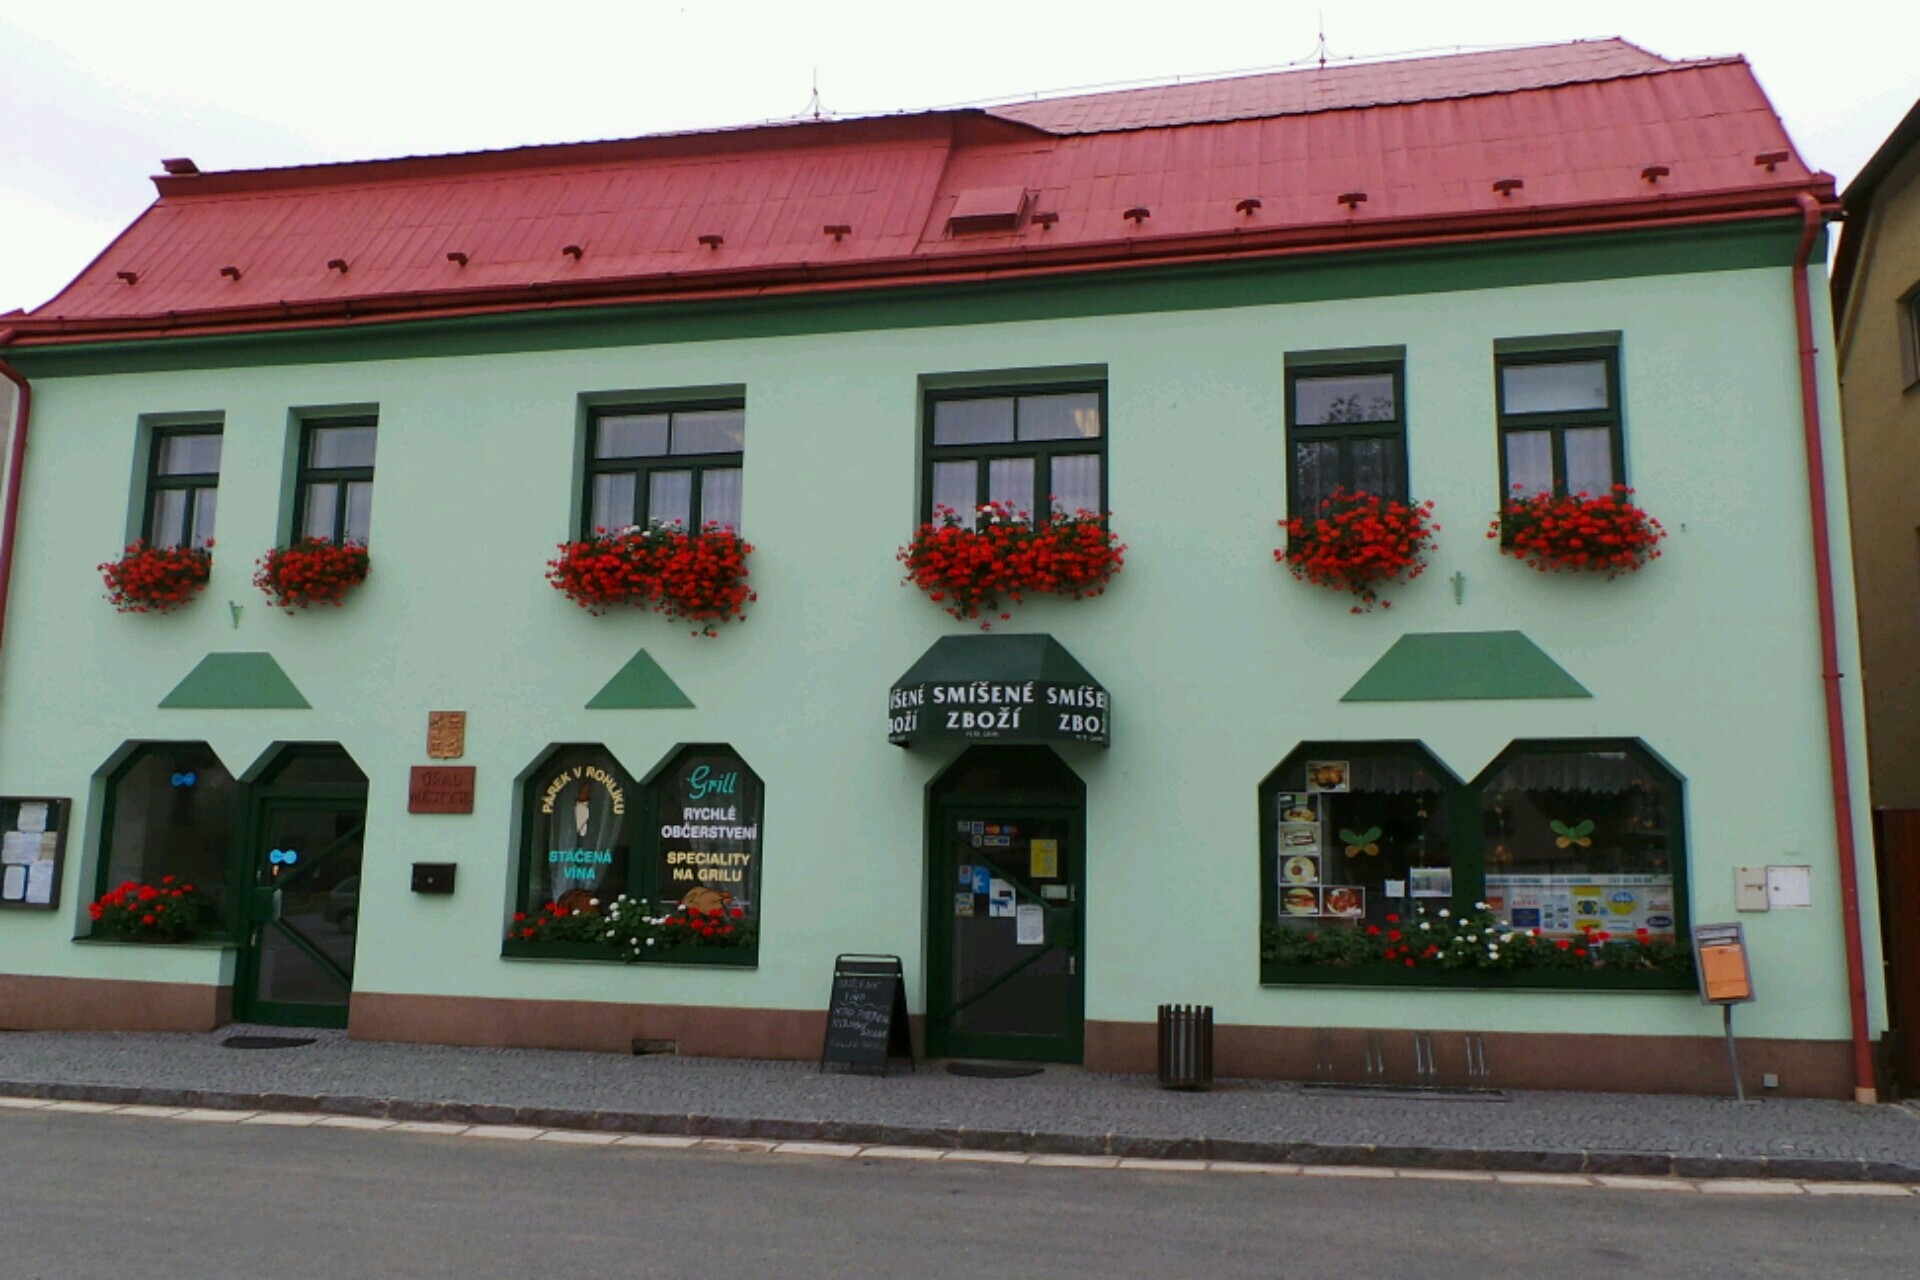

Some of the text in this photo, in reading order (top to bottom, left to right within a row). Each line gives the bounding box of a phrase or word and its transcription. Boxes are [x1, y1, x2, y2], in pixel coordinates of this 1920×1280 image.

[933, 681, 1034, 704] SMÍŠENÉ
[1046, 685, 1108, 710] SMÍŠE
[946, 707, 1022, 729] ZBOŽÍ
[541, 766, 625, 815] PÁREK V ROHLÍKU
[687, 765, 737, 799] Grill
[683, 805, 737, 820] RYCHLÉ
[661, 821, 757, 840] OBČERSTVENÍ
[549, 848, 612, 864] STÁČENÁ
[667, 851, 750, 866] SPECIALITY
[564, 865, 595, 880] VÍNA
[673, 867, 742, 882] NA GRILU
